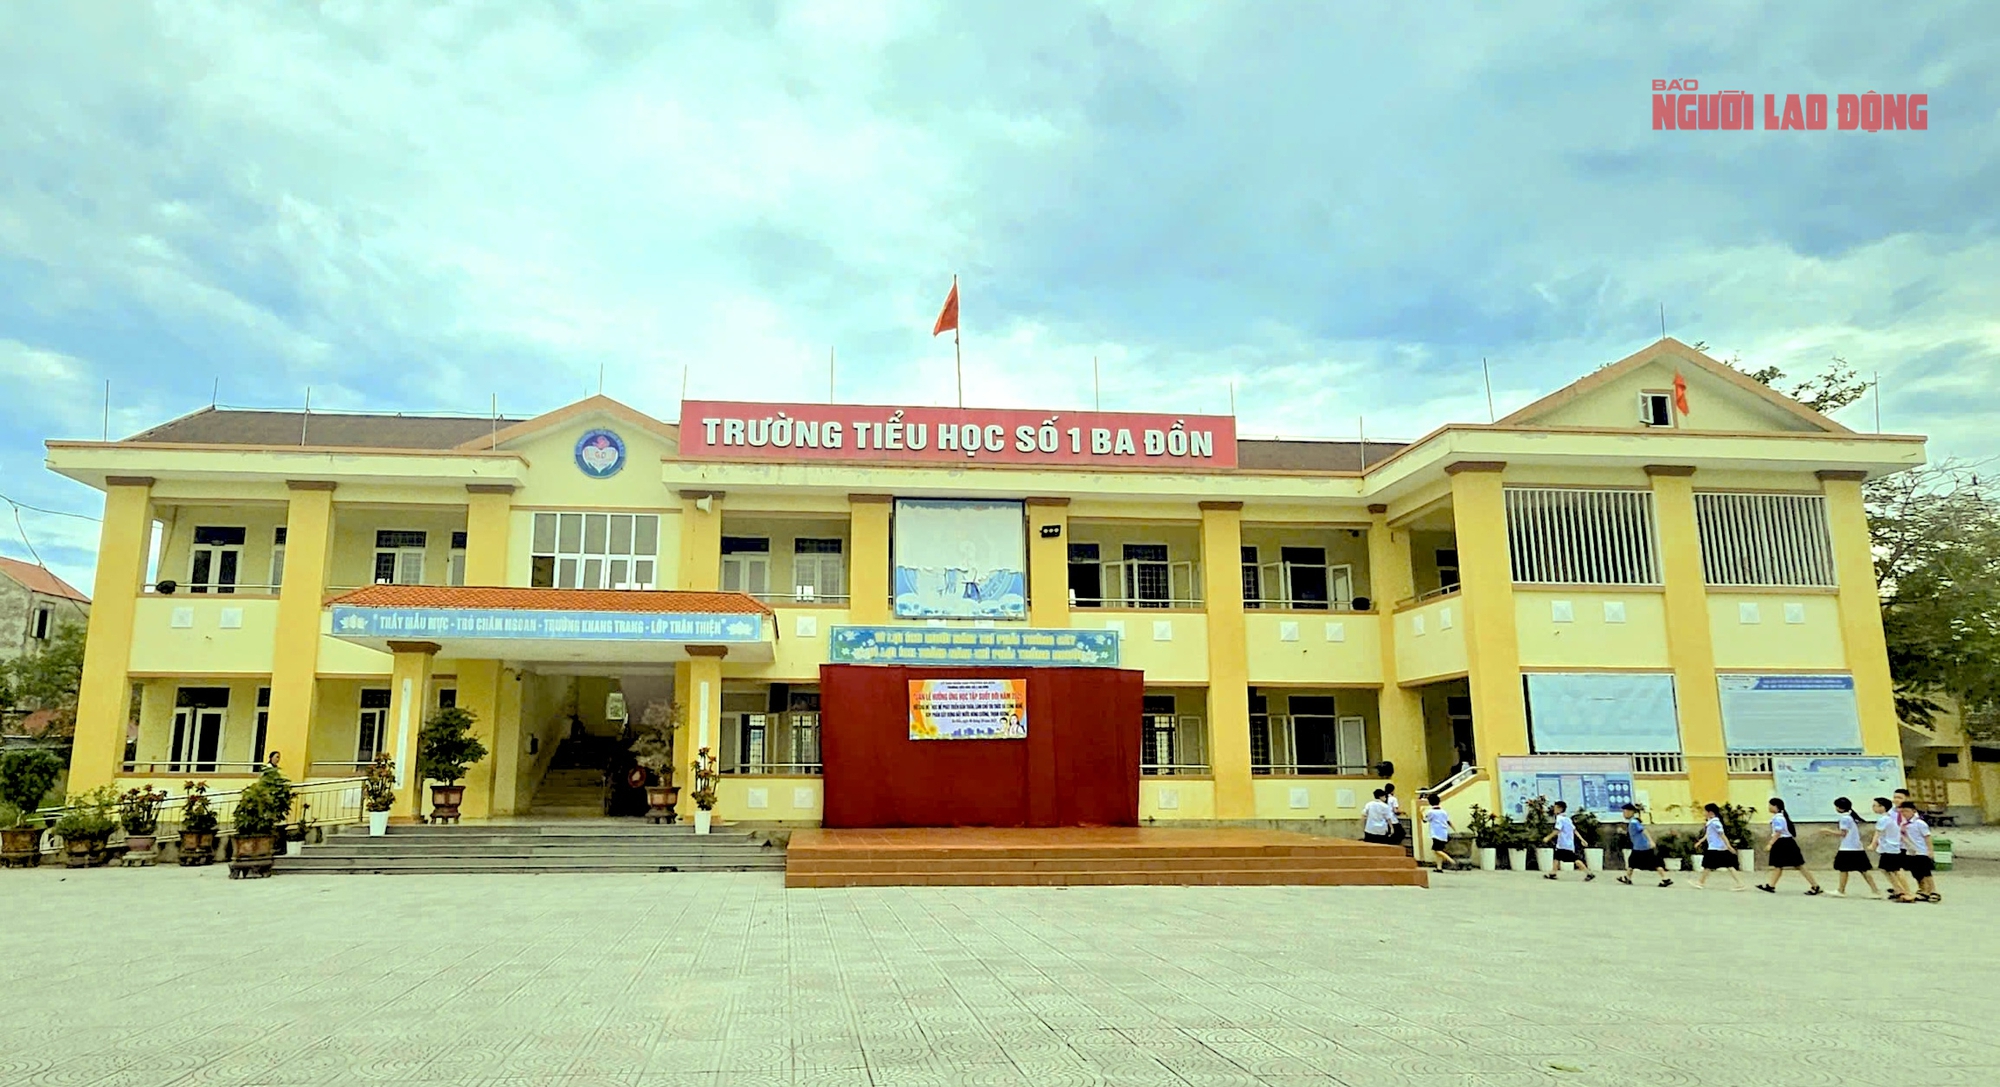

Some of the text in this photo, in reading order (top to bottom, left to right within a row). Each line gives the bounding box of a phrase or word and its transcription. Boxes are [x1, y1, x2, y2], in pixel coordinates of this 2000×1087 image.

[702, 409, 1213, 457] TRƯỜNG TIỂU HỌC SỐ 1 BA ĐỒN
